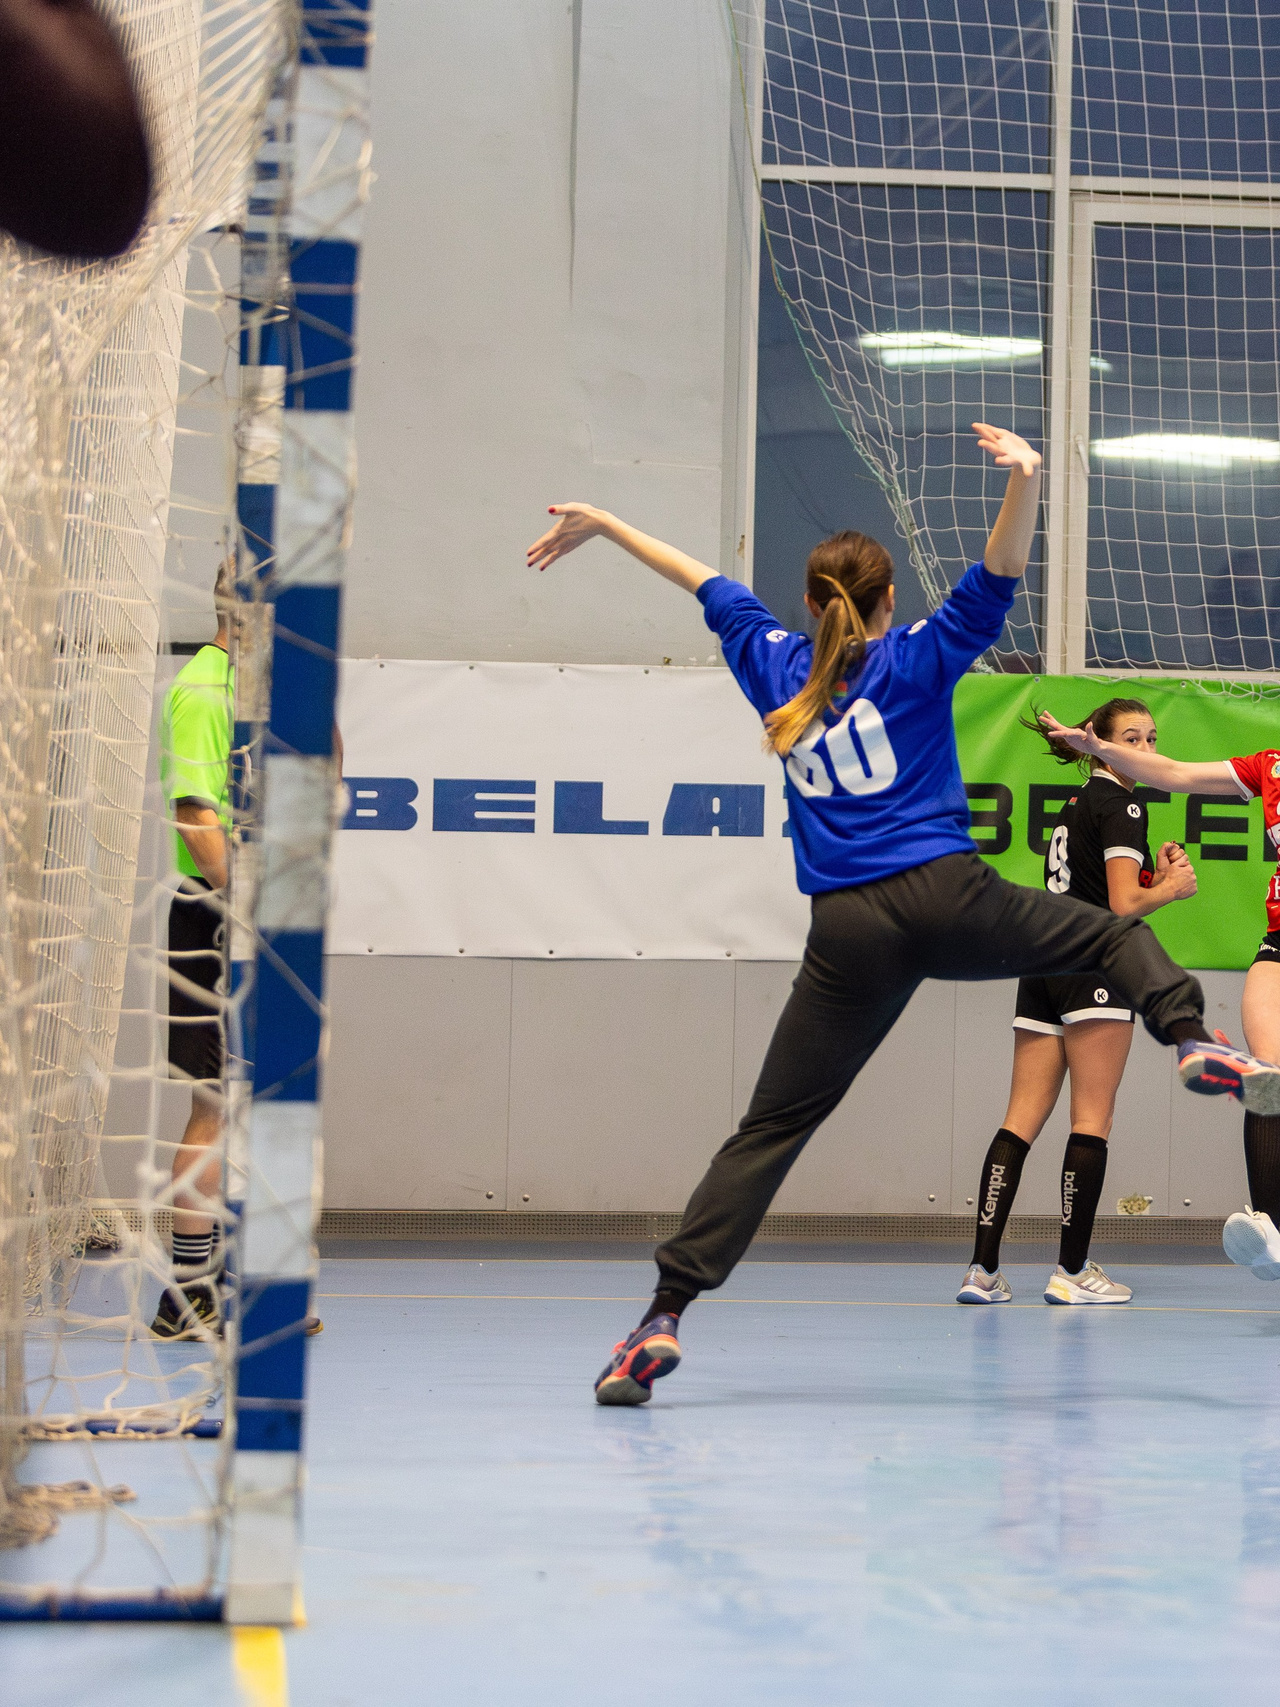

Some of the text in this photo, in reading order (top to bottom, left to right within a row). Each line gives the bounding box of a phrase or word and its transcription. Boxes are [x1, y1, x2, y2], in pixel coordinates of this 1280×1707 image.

[342, 777, 794, 838] BELA
[1047, 824, 1072, 894] 9
[979, 1163, 1007, 1227] Kempa
[1061, 1171, 1079, 1227] Kempa
